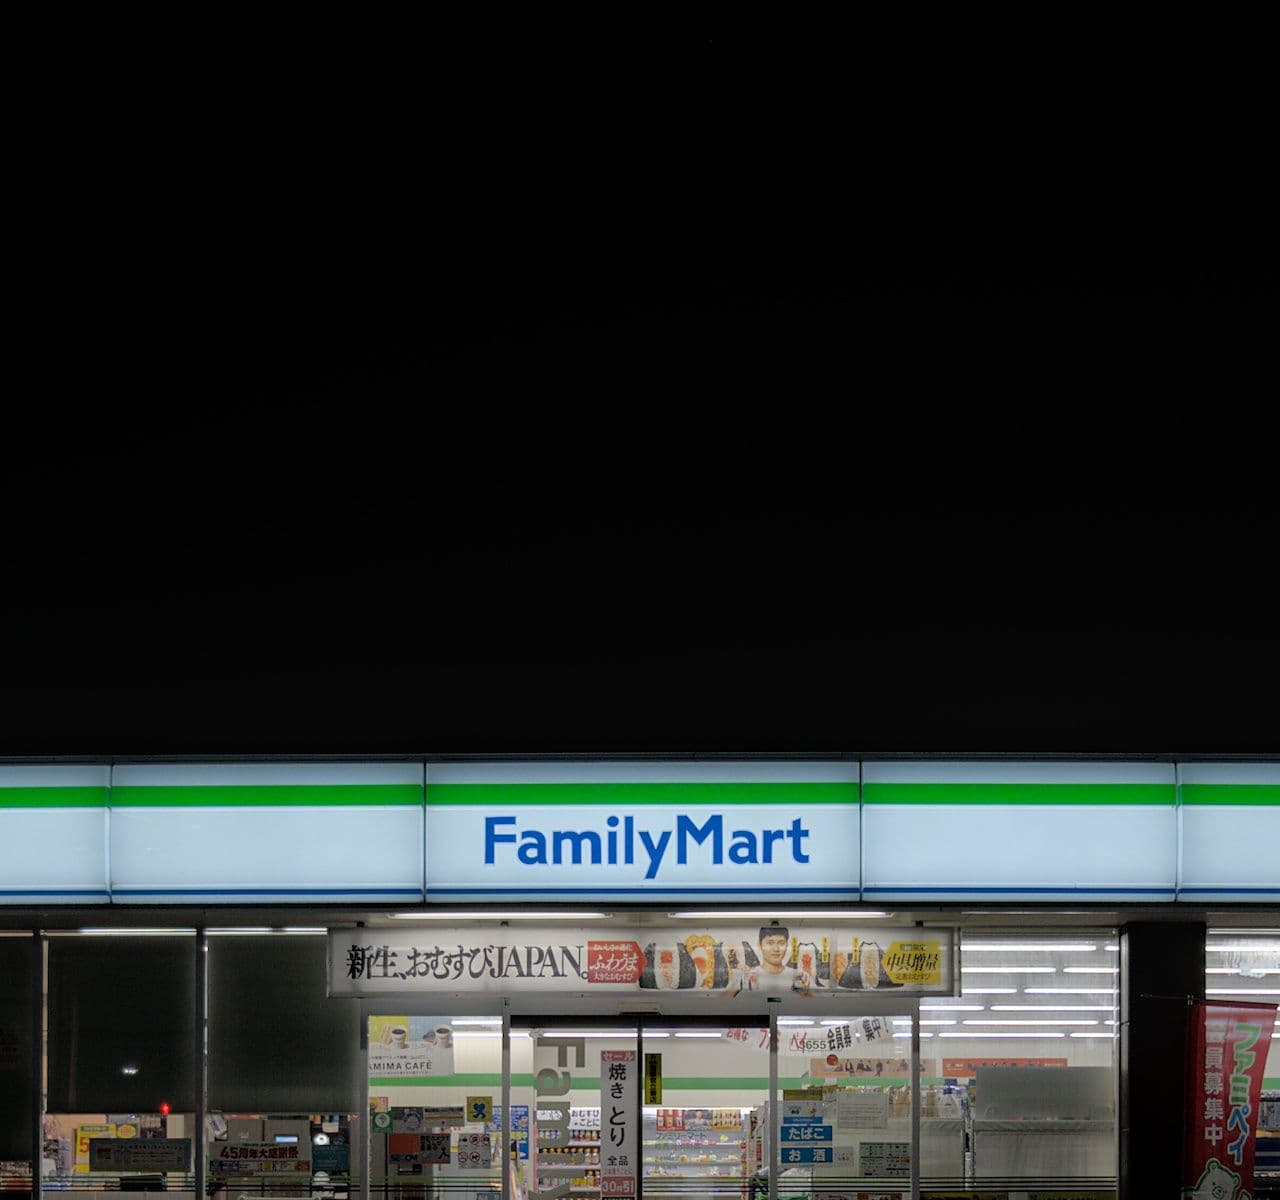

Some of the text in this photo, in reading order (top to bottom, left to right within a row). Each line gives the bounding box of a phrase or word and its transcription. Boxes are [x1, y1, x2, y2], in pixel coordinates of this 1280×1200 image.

[484, 814, 810, 879] FamilyMart
[609, 1063, 626, 1147] 焼きとり
[1227, 1022, 1262, 1165] ファミペイ
[788, 1127, 825, 1140] たばこ
